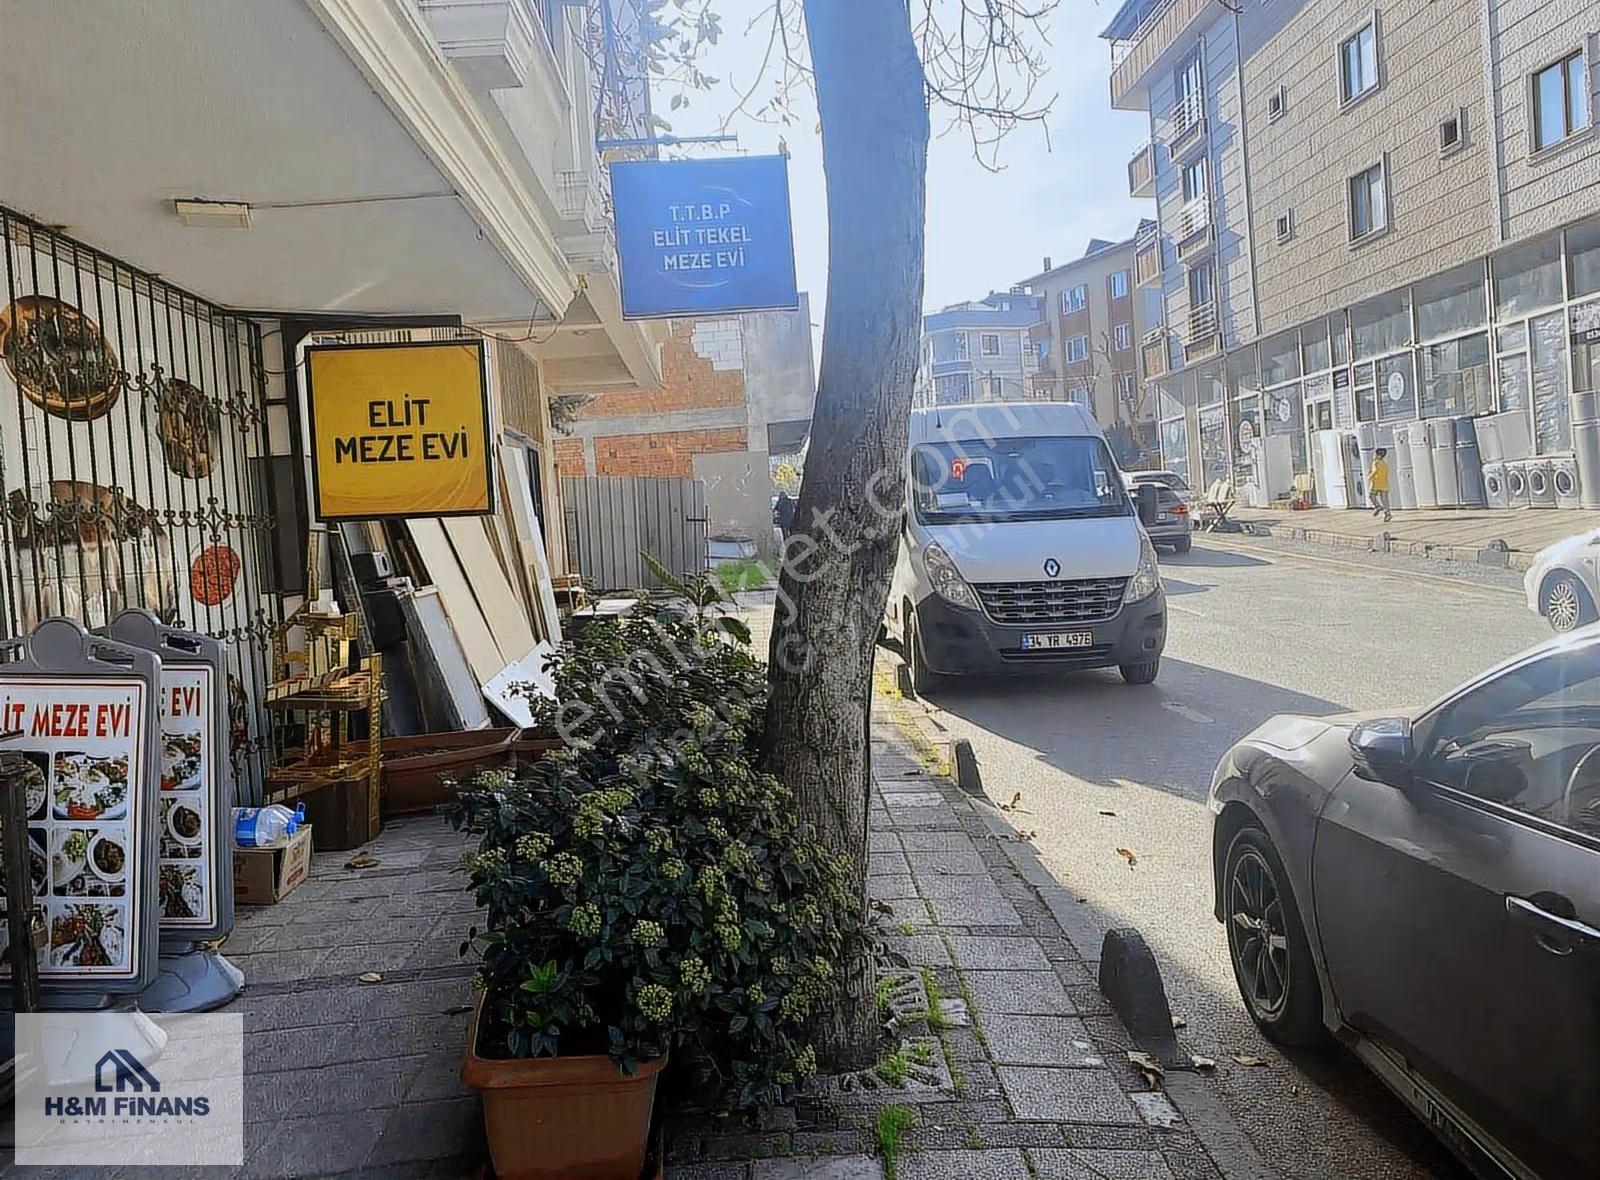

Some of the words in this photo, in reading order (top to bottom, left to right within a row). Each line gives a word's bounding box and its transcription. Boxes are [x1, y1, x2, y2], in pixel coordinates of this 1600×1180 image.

[668, 203, 731, 221] T.T.B.P
[653, 225, 690, 246] ELİT
[695, 226, 752, 244] TEKEL
[664, 253, 712, 270] MEZE
[716, 247, 745, 267] EVİ
[368, 393, 430, 428] ELİT
[334, 434, 415, 464] MEZE
[422, 425, 468, 460] EVİ
[1029, 635, 1042, 648] 34
[171, 680, 201, 717] EVİ
[0, 696, 26, 731] İT
[31, 703, 90, 737] MEZE
[95, 696, 131, 737] EVİ
